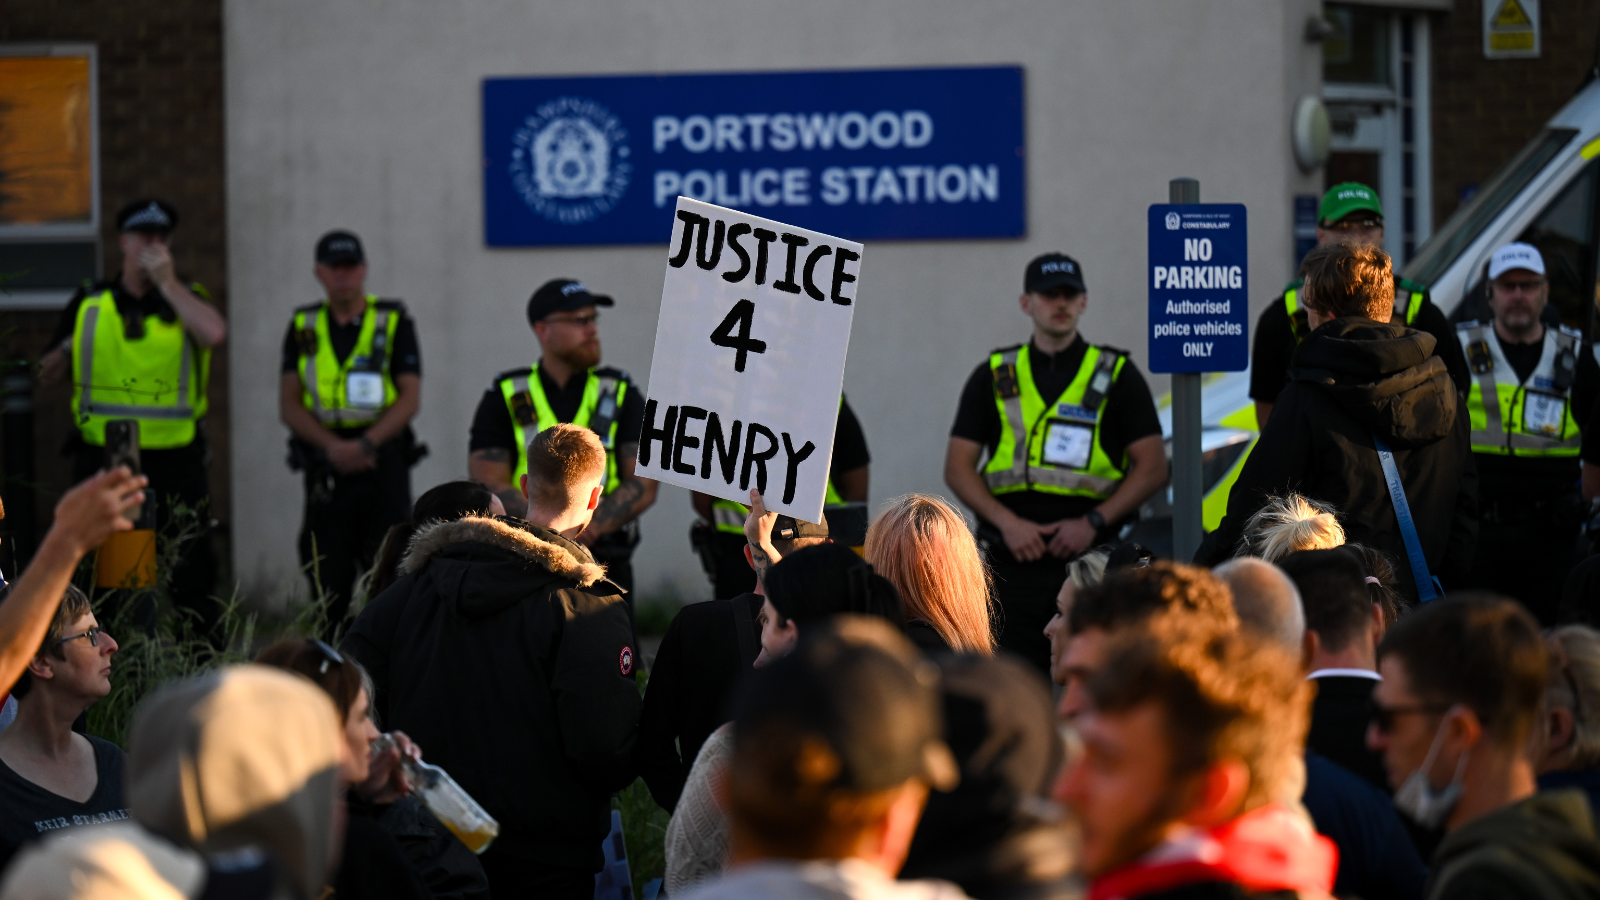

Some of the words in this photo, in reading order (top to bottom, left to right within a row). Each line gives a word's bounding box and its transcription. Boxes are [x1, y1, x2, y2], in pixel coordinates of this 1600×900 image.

[653, 112, 933, 153] PORTSWOOD
[653, 169, 811, 207] POLICE
[821, 165, 999, 206] STATION
[1338, 189, 1370, 201] POLICE
[669, 210, 860, 305] JUSTICE
[1184, 238, 1212, 261] NO
[1502, 251, 1531, 262] POLICE
[1041, 261, 1075, 275] POLICE
[1154, 266, 1242, 289] PARKING
[1165, 300, 1230, 315] Authorised
[710, 298, 767, 373] 4
[1154, 321, 1190, 339] police
[1193, 321, 1242, 336] vehicles
[1183, 342, 1214, 357] ONLY
[638, 399, 816, 505] HENRY
[34, 816, 70, 833] KEIR
